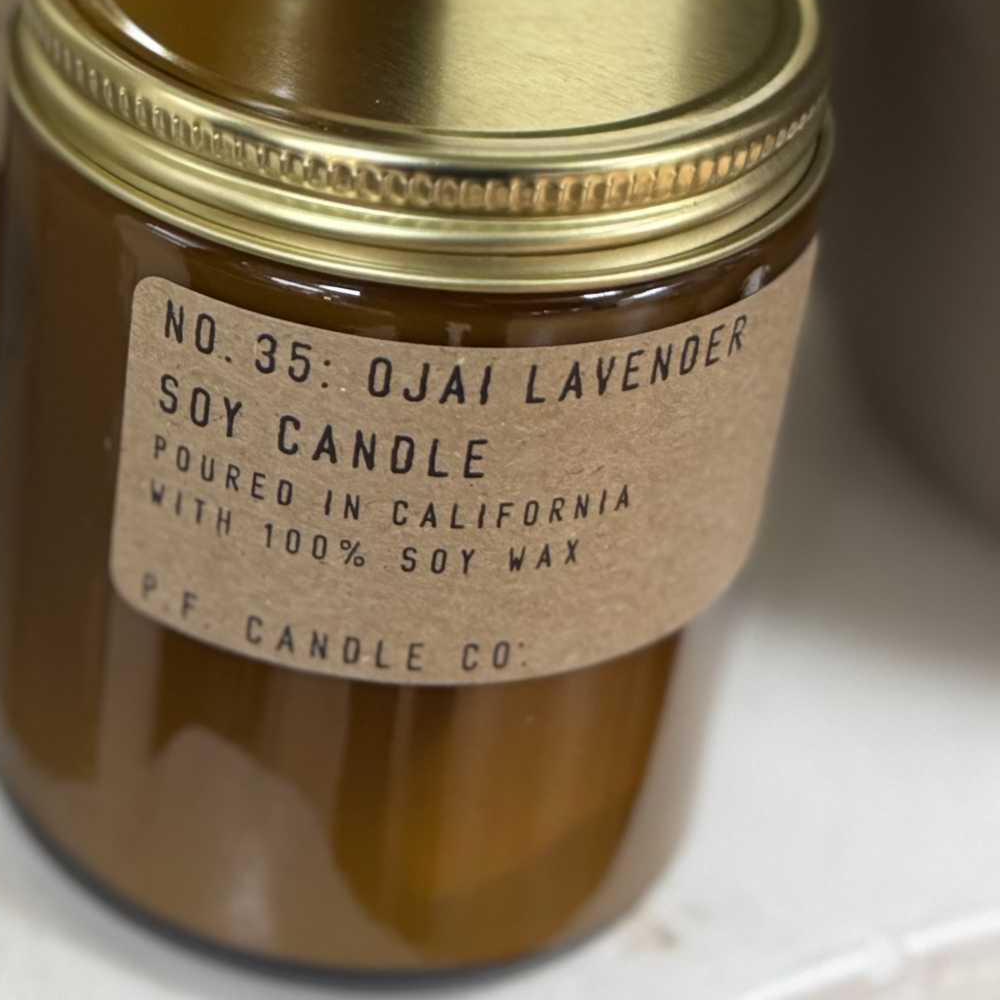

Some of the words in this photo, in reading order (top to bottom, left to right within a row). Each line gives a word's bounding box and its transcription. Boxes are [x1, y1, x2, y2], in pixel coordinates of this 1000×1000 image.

[164, 300, 232, 363] NO.
[254, 333, 331, 388] 35:
[367, 357, 492, 404] OJAI
[525, 314, 749, 404] LAVENDER
[158, 375, 243, 438] SOY
[277, 415, 489, 479] CANDLE
[150, 480, 231, 537] WITH
[264, 522, 365, 568] 100%
[401, 547, 475, 575] SOY
[508, 539, 580, 572] WAX
[153, 434, 293, 505] POURED
[324, 490, 361, 520] IN
[393, 485, 632, 529] CALIFORNIA
[246, 615, 425, 671] CANDLE
